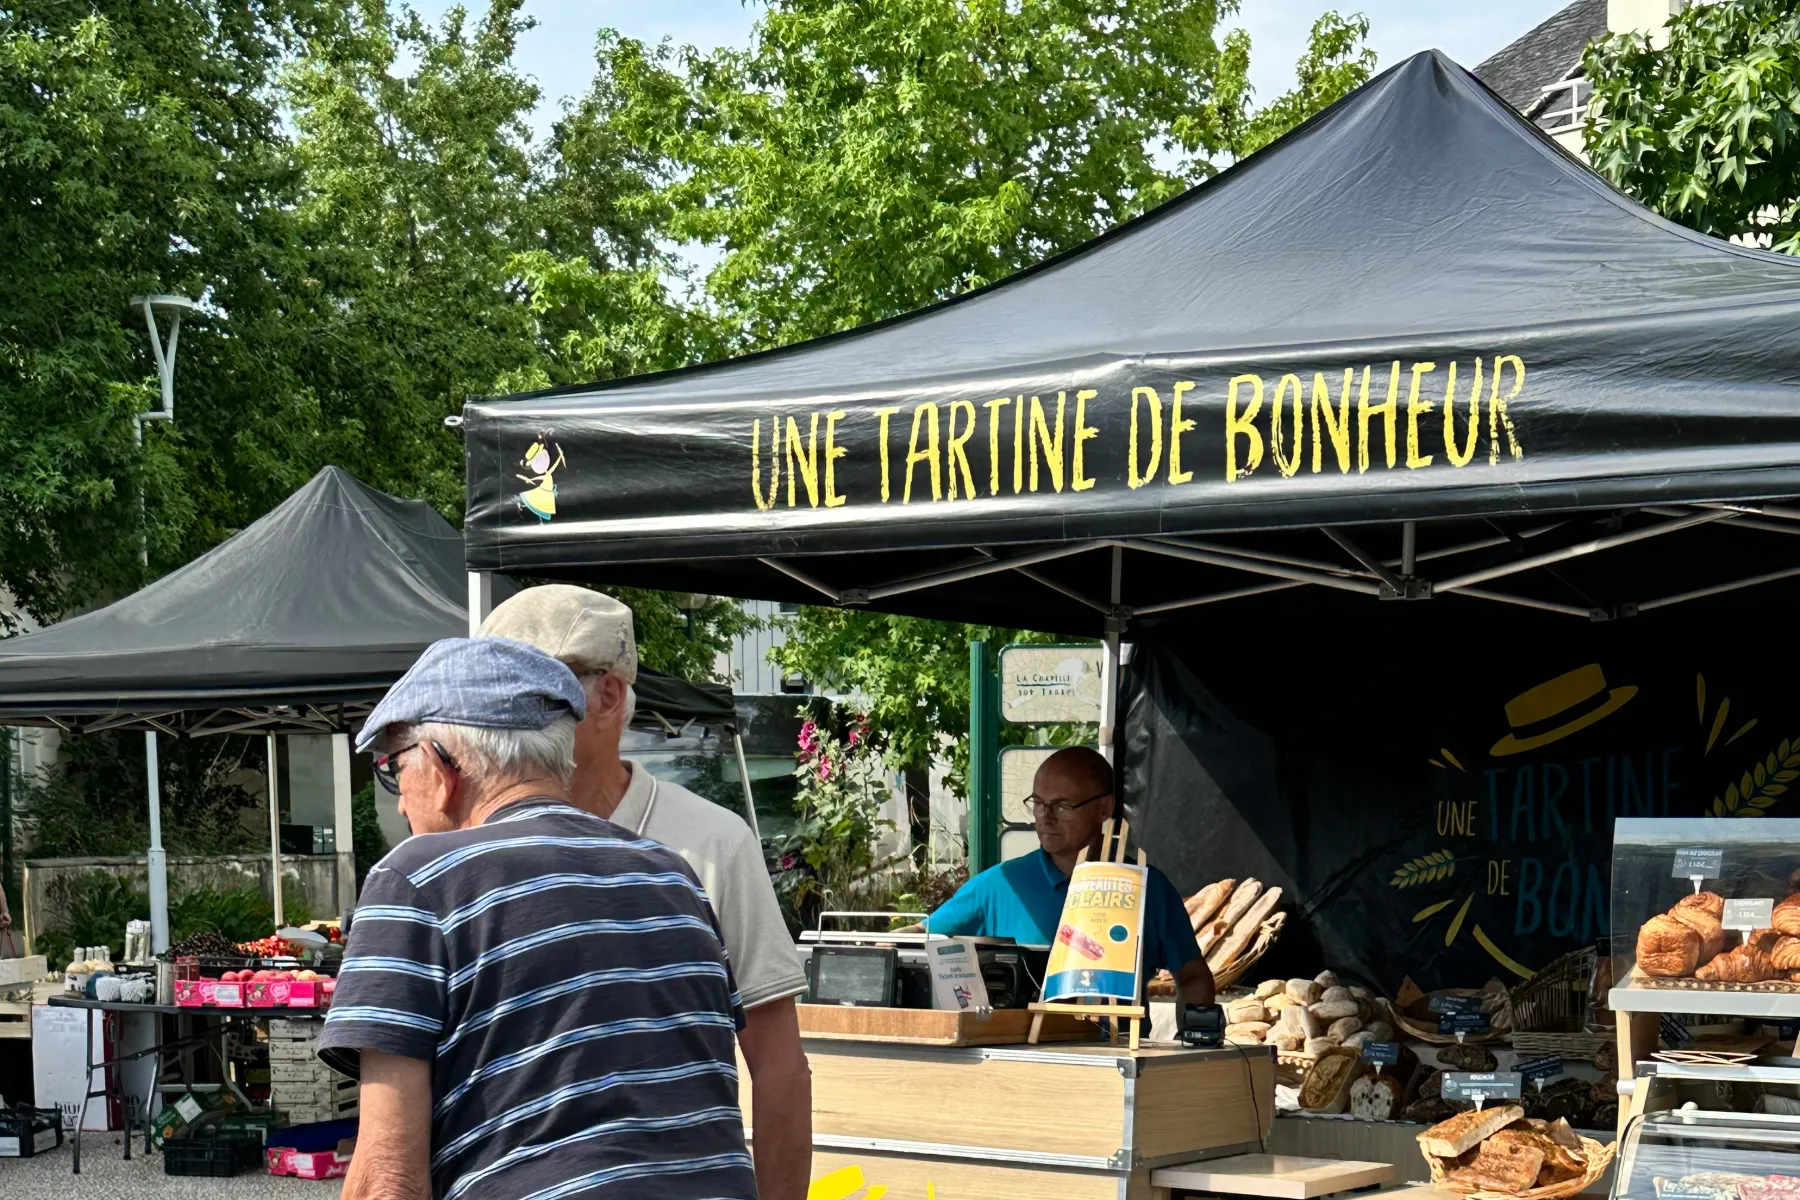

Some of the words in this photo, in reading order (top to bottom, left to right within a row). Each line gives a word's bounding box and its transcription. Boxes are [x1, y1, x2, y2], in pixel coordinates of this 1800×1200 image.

[752, 410, 847, 512] UNE
[872, 389, 1100, 504] TARTINE
[1127, 381, 1198, 489] DE
[1226, 354, 1526, 484] BONHEUR
[1437, 800, 1478, 836] UNE
[1483, 746, 1684, 843] TARTINE
[1066, 890, 1136, 911] CLAIRS
[1487, 859, 1511, 895] DE
